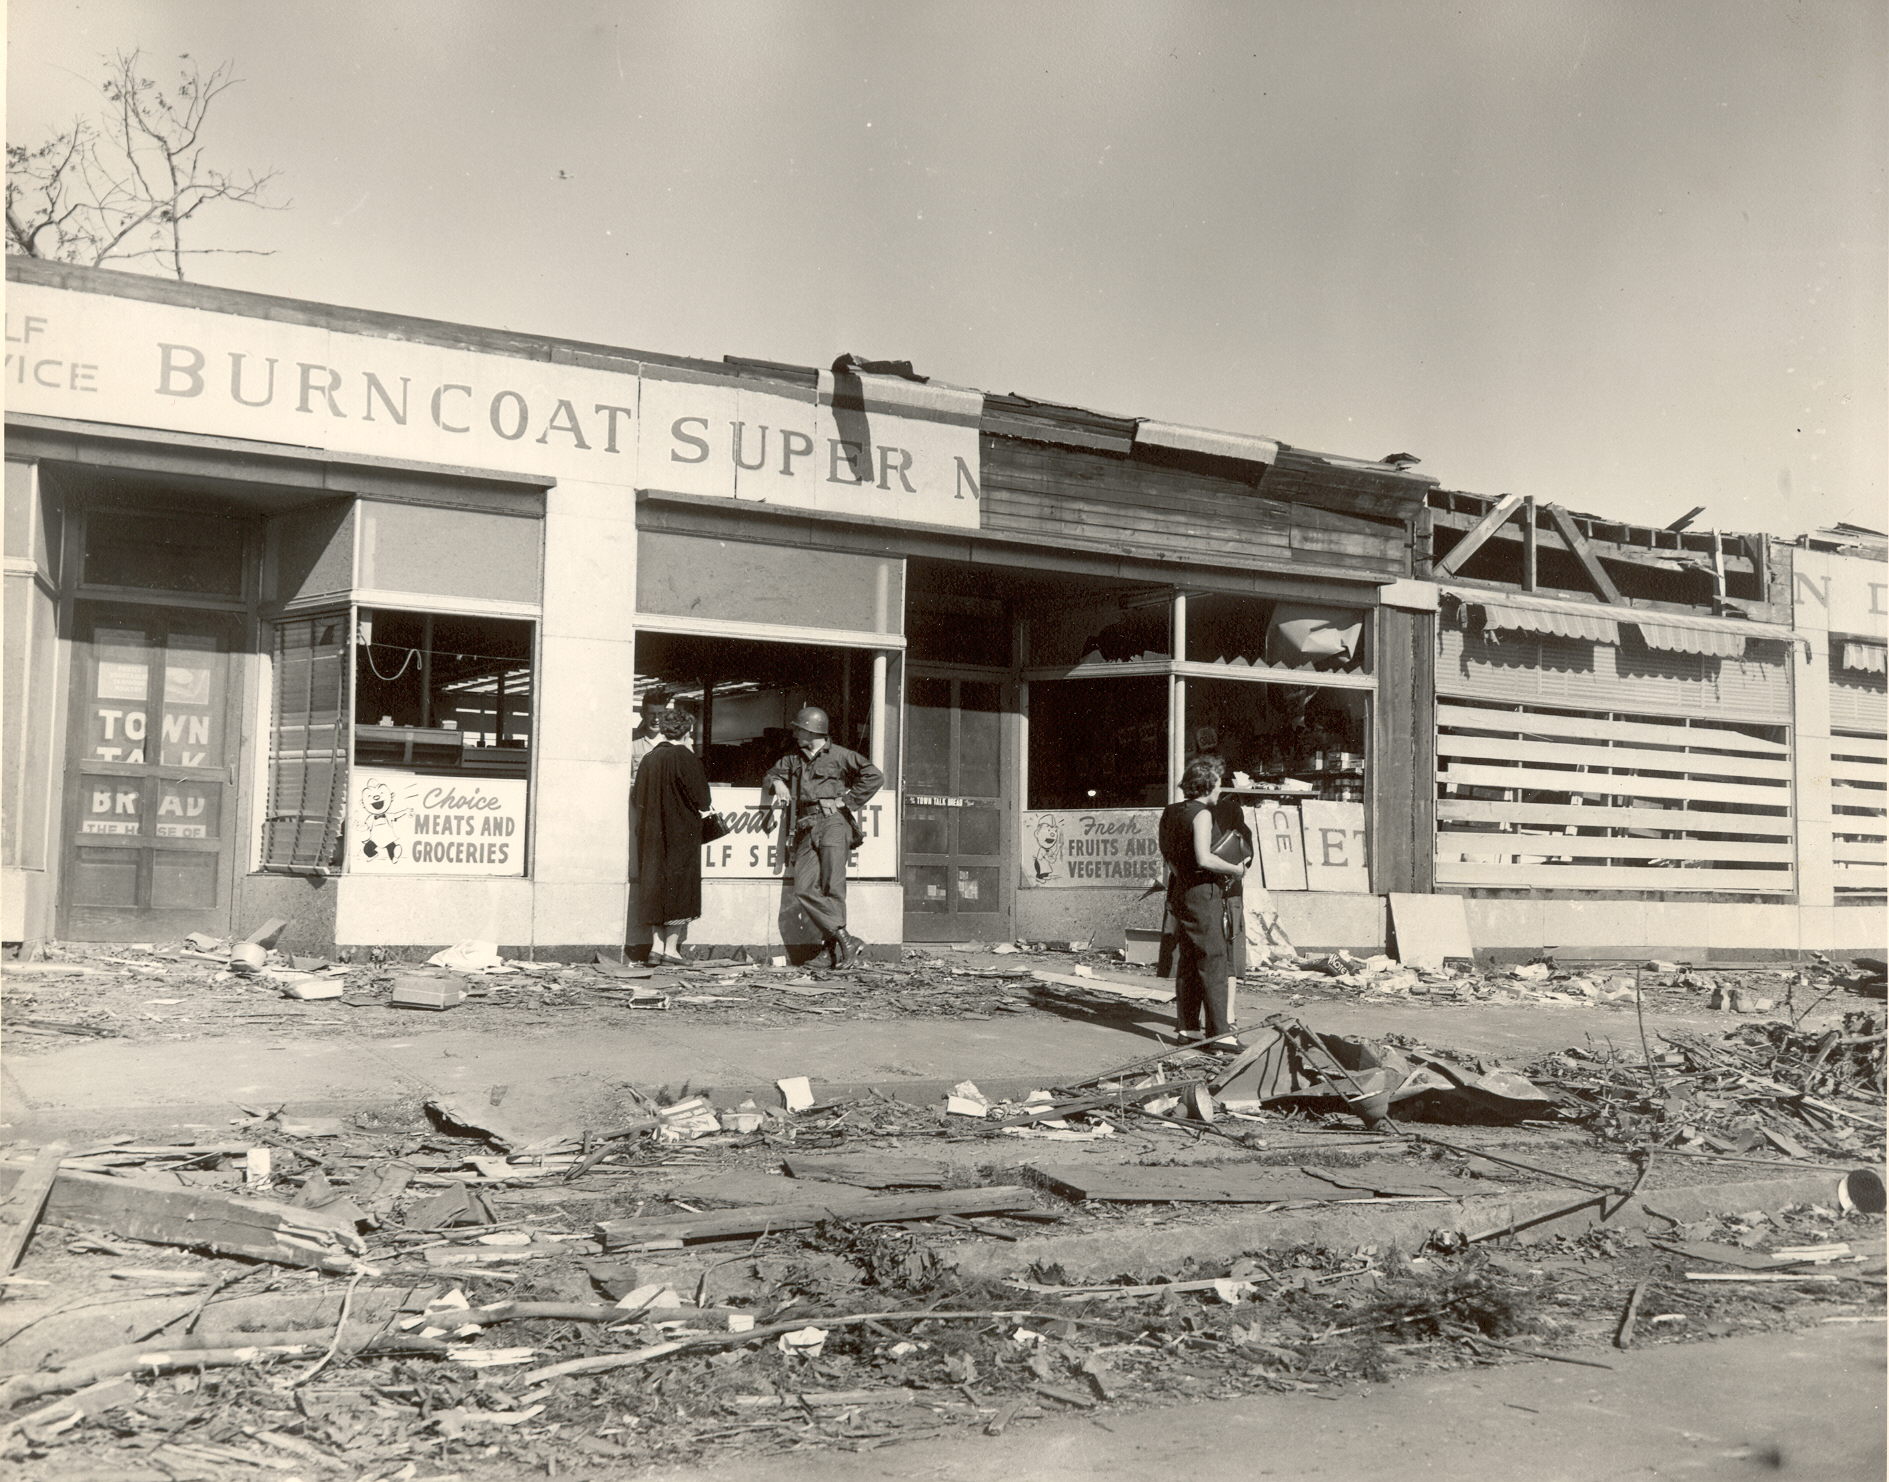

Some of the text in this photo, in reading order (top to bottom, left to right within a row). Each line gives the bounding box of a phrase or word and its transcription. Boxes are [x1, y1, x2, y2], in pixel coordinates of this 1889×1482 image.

[154, 341, 632, 454] BURNCOAT
[670, 415, 917, 494] SUPER
[98, 709, 210, 745] TOWN
[96, 746, 207, 768] TK
[92, 785, 205, 817] BRAD
[422, 787, 502, 811] Choice
[87, 824, 118, 836] THE
[414, 814, 516, 837] MEATS AND
[718, 805, 784, 834] coat
[1079, 814, 1141, 836] Fresh
[411, 840, 510, 864] GROCERIES
[1068, 838, 1158, 857] FRUITS AND
[1068, 860, 1158, 879] VEGETABLES
